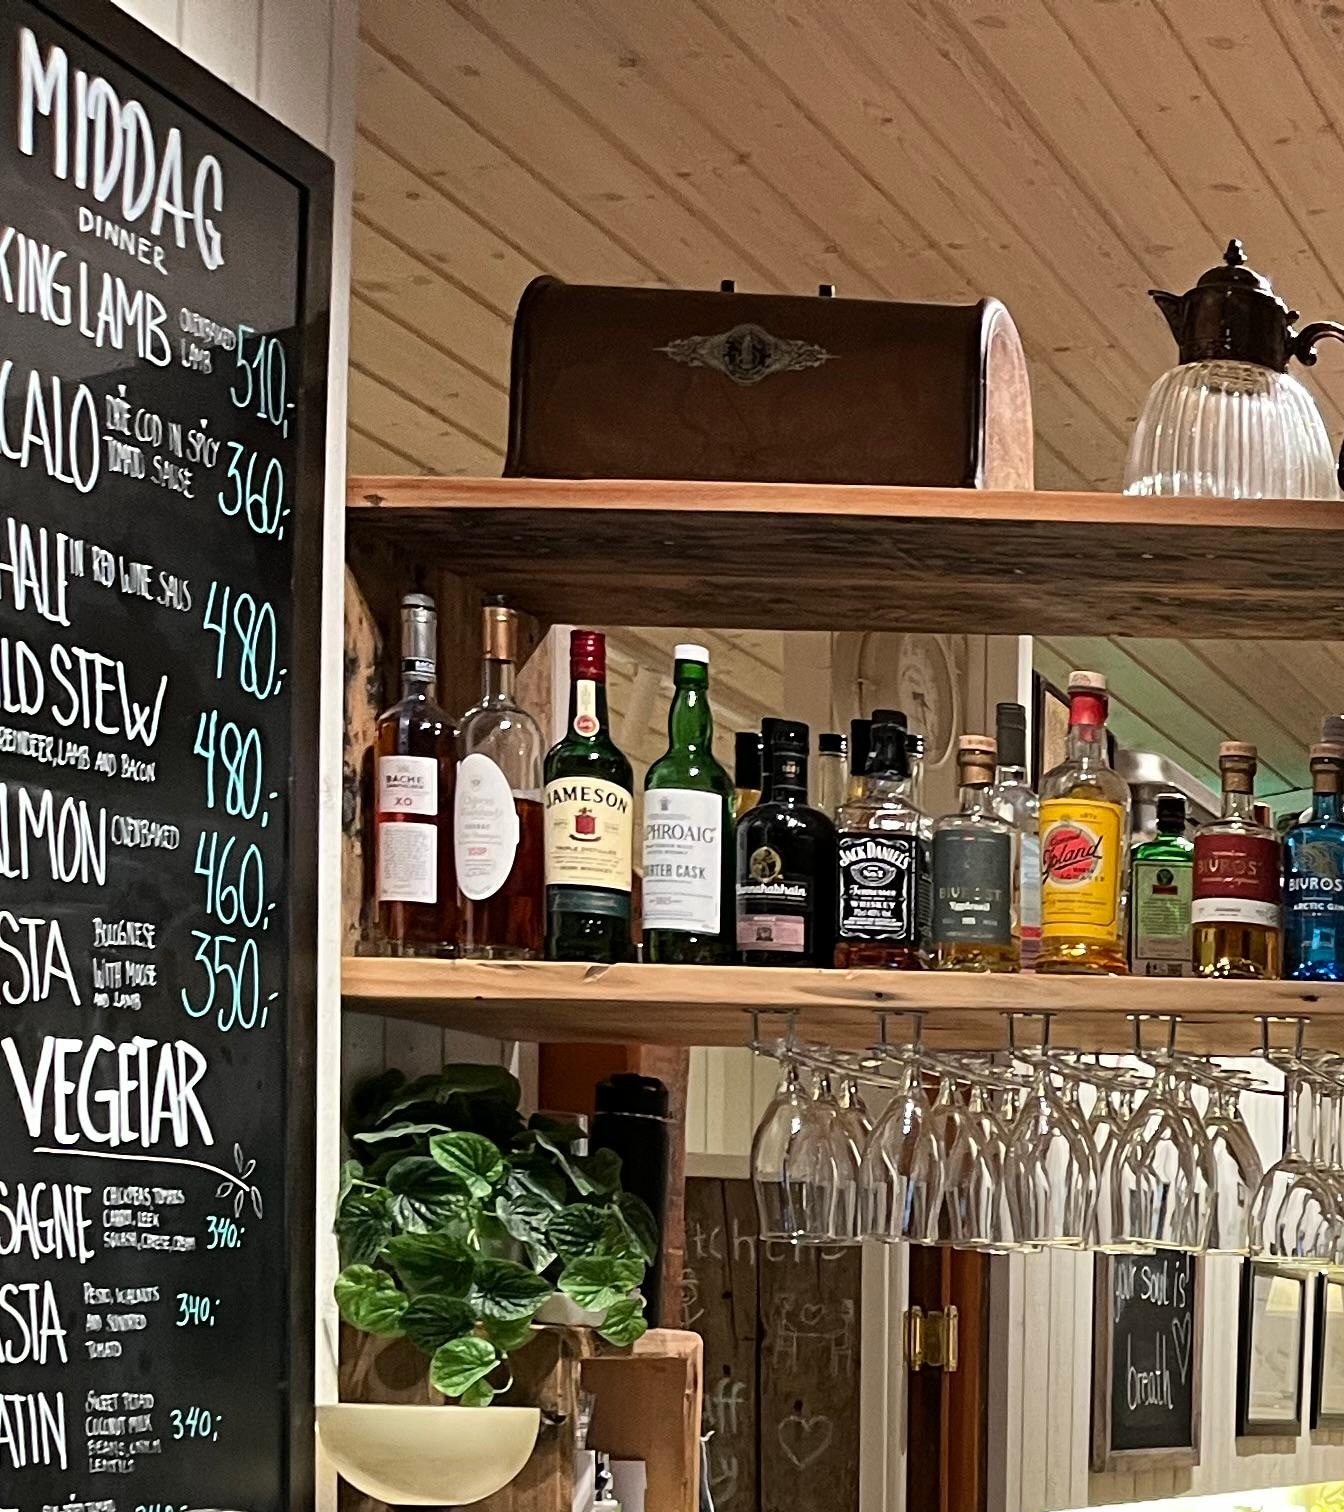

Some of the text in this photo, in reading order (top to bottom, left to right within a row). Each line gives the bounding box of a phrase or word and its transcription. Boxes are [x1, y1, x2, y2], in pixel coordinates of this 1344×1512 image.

[18, 26, 226, 271] MIDDAG
[78, 206, 168, 276] DINNER
[79, 261, 172, 367] LAMB
[50, 643, 168, 746] STEW
[546, 786, 629, 814] JAMESON
[675, 865, 706, 880] CASK
[1, 1034, 214, 1147] VEGETAR
